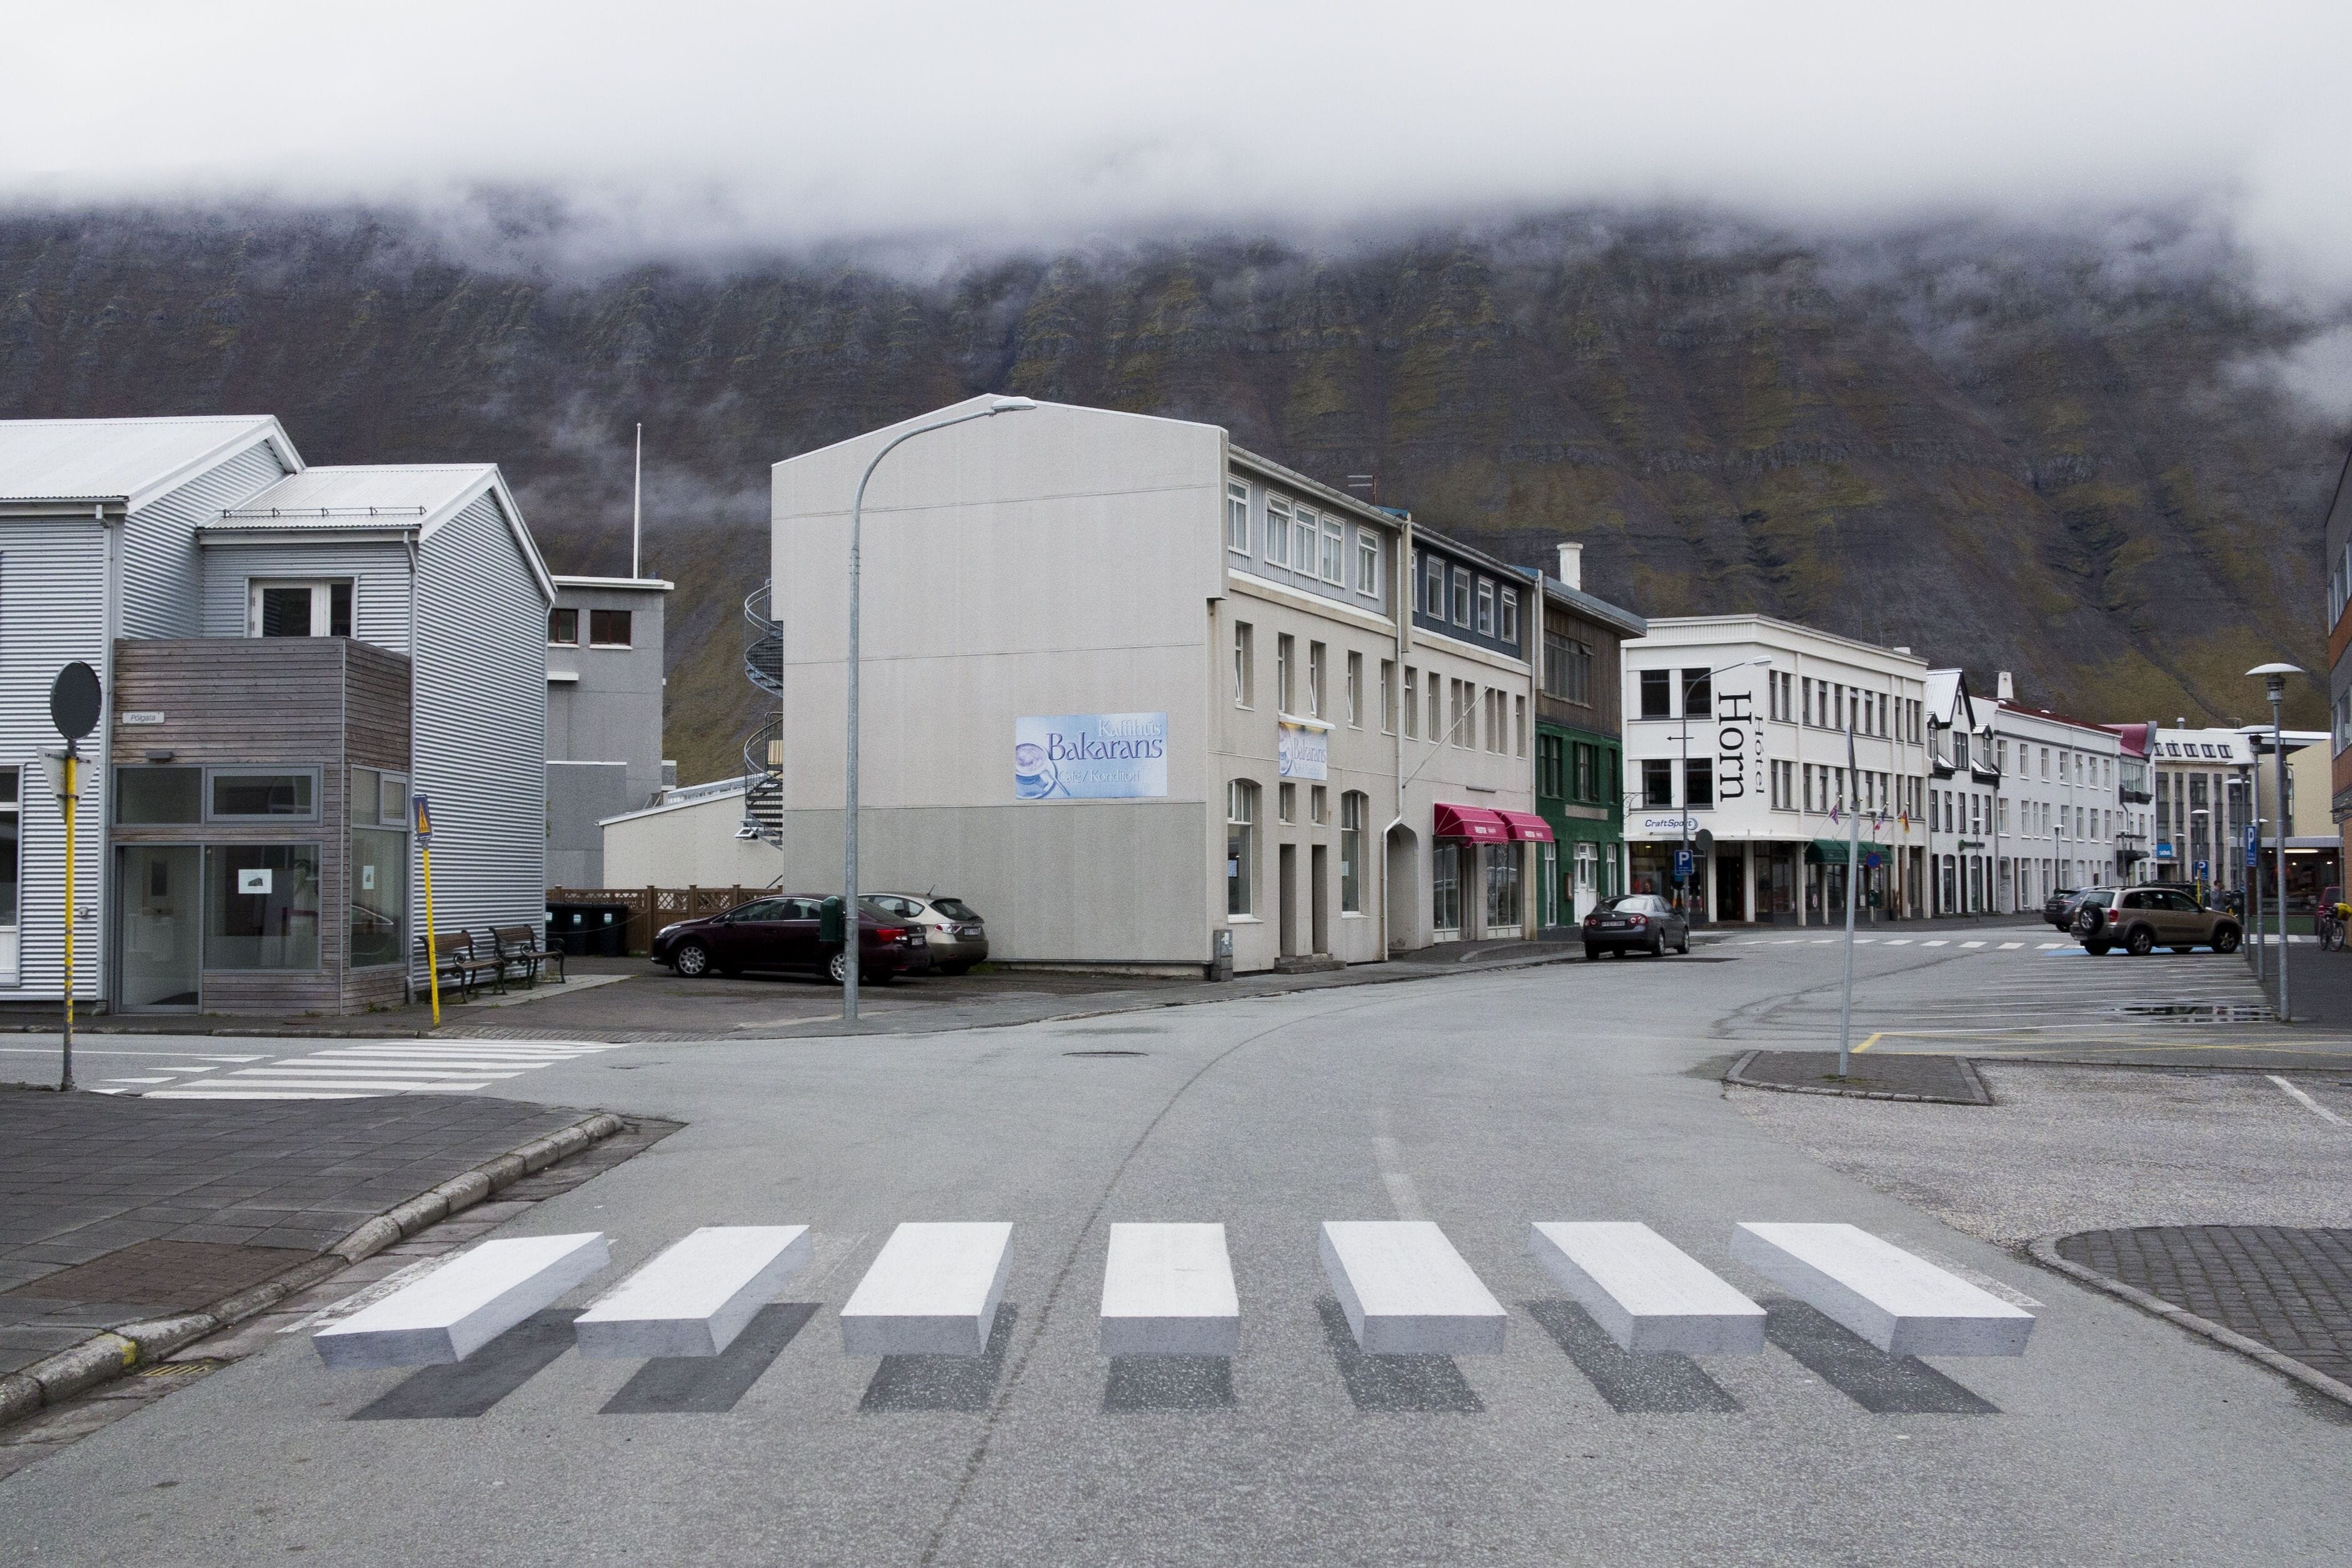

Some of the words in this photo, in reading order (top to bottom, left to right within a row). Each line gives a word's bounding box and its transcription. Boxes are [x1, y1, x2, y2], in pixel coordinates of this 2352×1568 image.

[1098, 719, 1162, 737] Kaffihús
[1046, 731, 1163, 761] Bakarans
[1294, 738, 1326, 763] Bakarans
[1718, 690, 1752, 802] Horn
[1090, 769, 1140, 782] Konditori
[1645, 819, 1692, 828] CraftSpot
[1679, 852, 1689, 865] P
